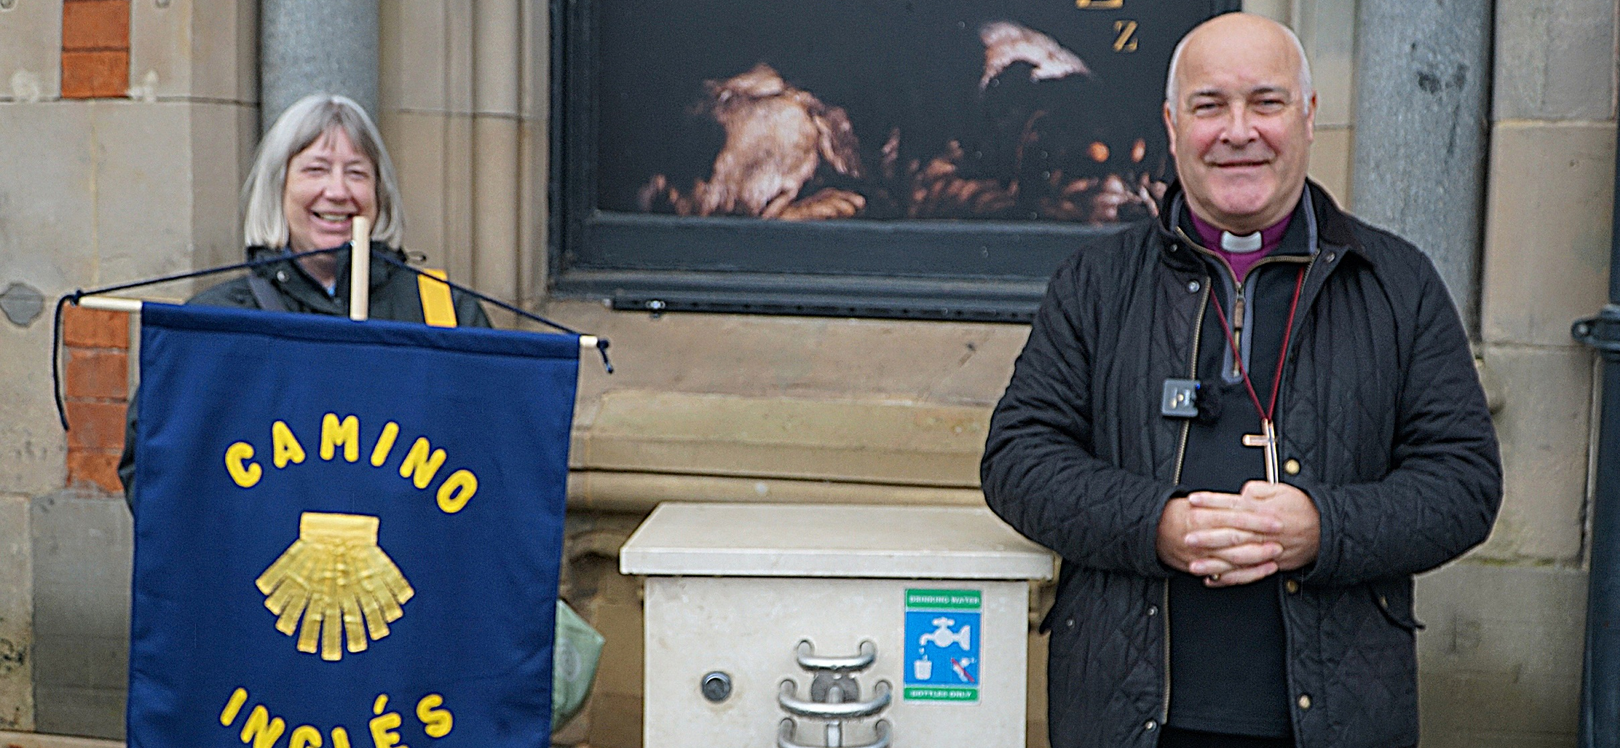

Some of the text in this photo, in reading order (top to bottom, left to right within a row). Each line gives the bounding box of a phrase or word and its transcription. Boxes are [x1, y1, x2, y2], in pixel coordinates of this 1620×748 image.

[225, 413, 478, 513] CAMINO
[909, 595, 980, 604] DRINKING WATER
[949, 691, 972, 699] ONLY
